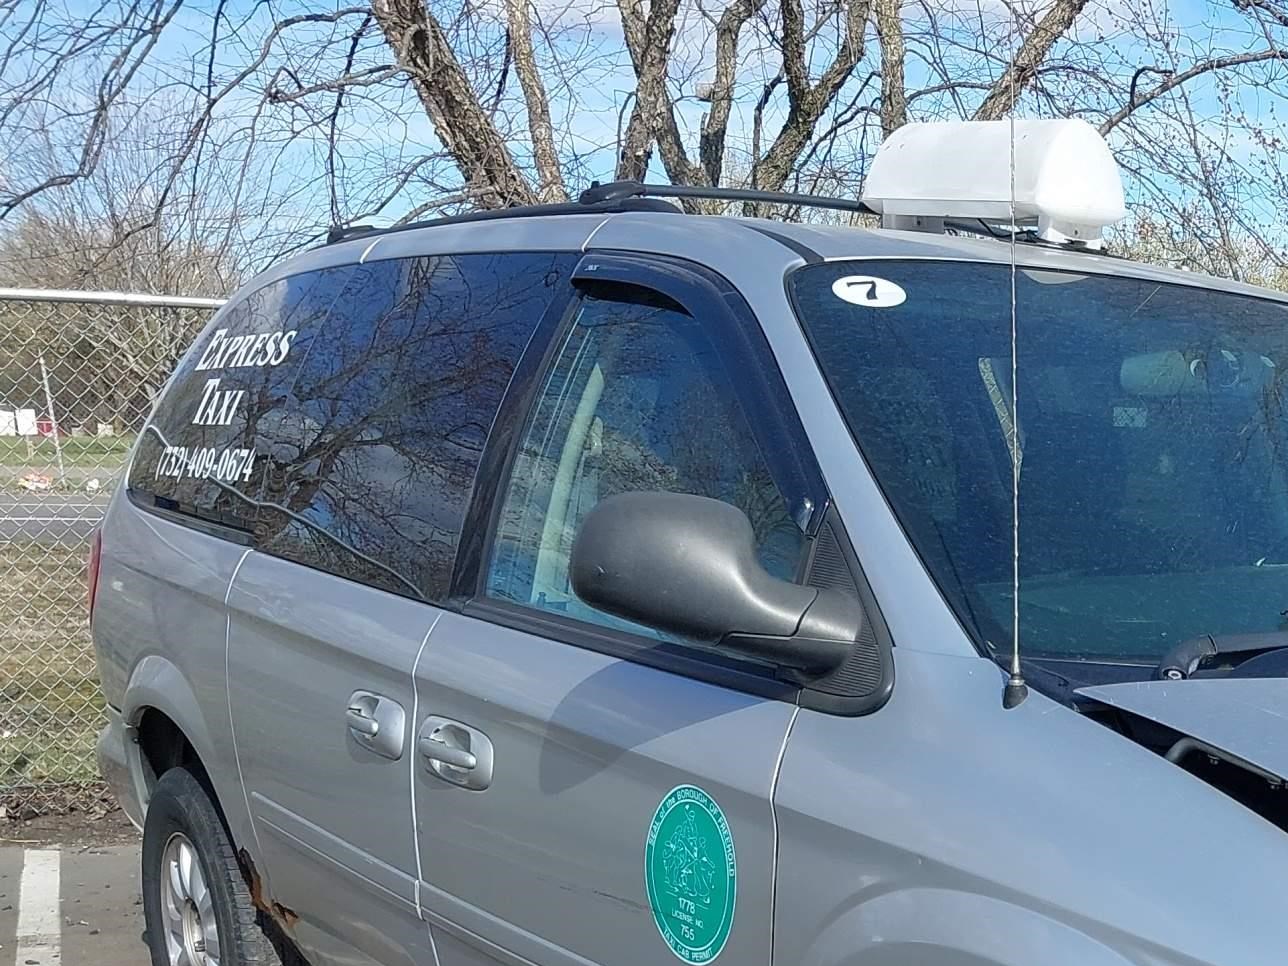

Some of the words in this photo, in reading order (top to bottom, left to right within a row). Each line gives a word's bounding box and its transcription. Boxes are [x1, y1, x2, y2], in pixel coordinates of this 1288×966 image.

[846, 280, 879, 300] 7
[195, 328, 297, 371] EXPRESS
[192, 378, 245, 425] TAXI
[649, 820, 660, 844] SEAL
[676, 788, 708, 805] BOROUGH
[709, 803, 719, 816] OF
[717, 816, 736, 877] FREEHOLD
[671, 907, 693, 925] LICENSE
[678, 897, 696, 914] 1778
[663, 928, 676, 948] TAXI
[677, 944, 690, 959] CAB
[691, 947, 713, 961] PERMIT
[680, 924, 695, 941] 755
